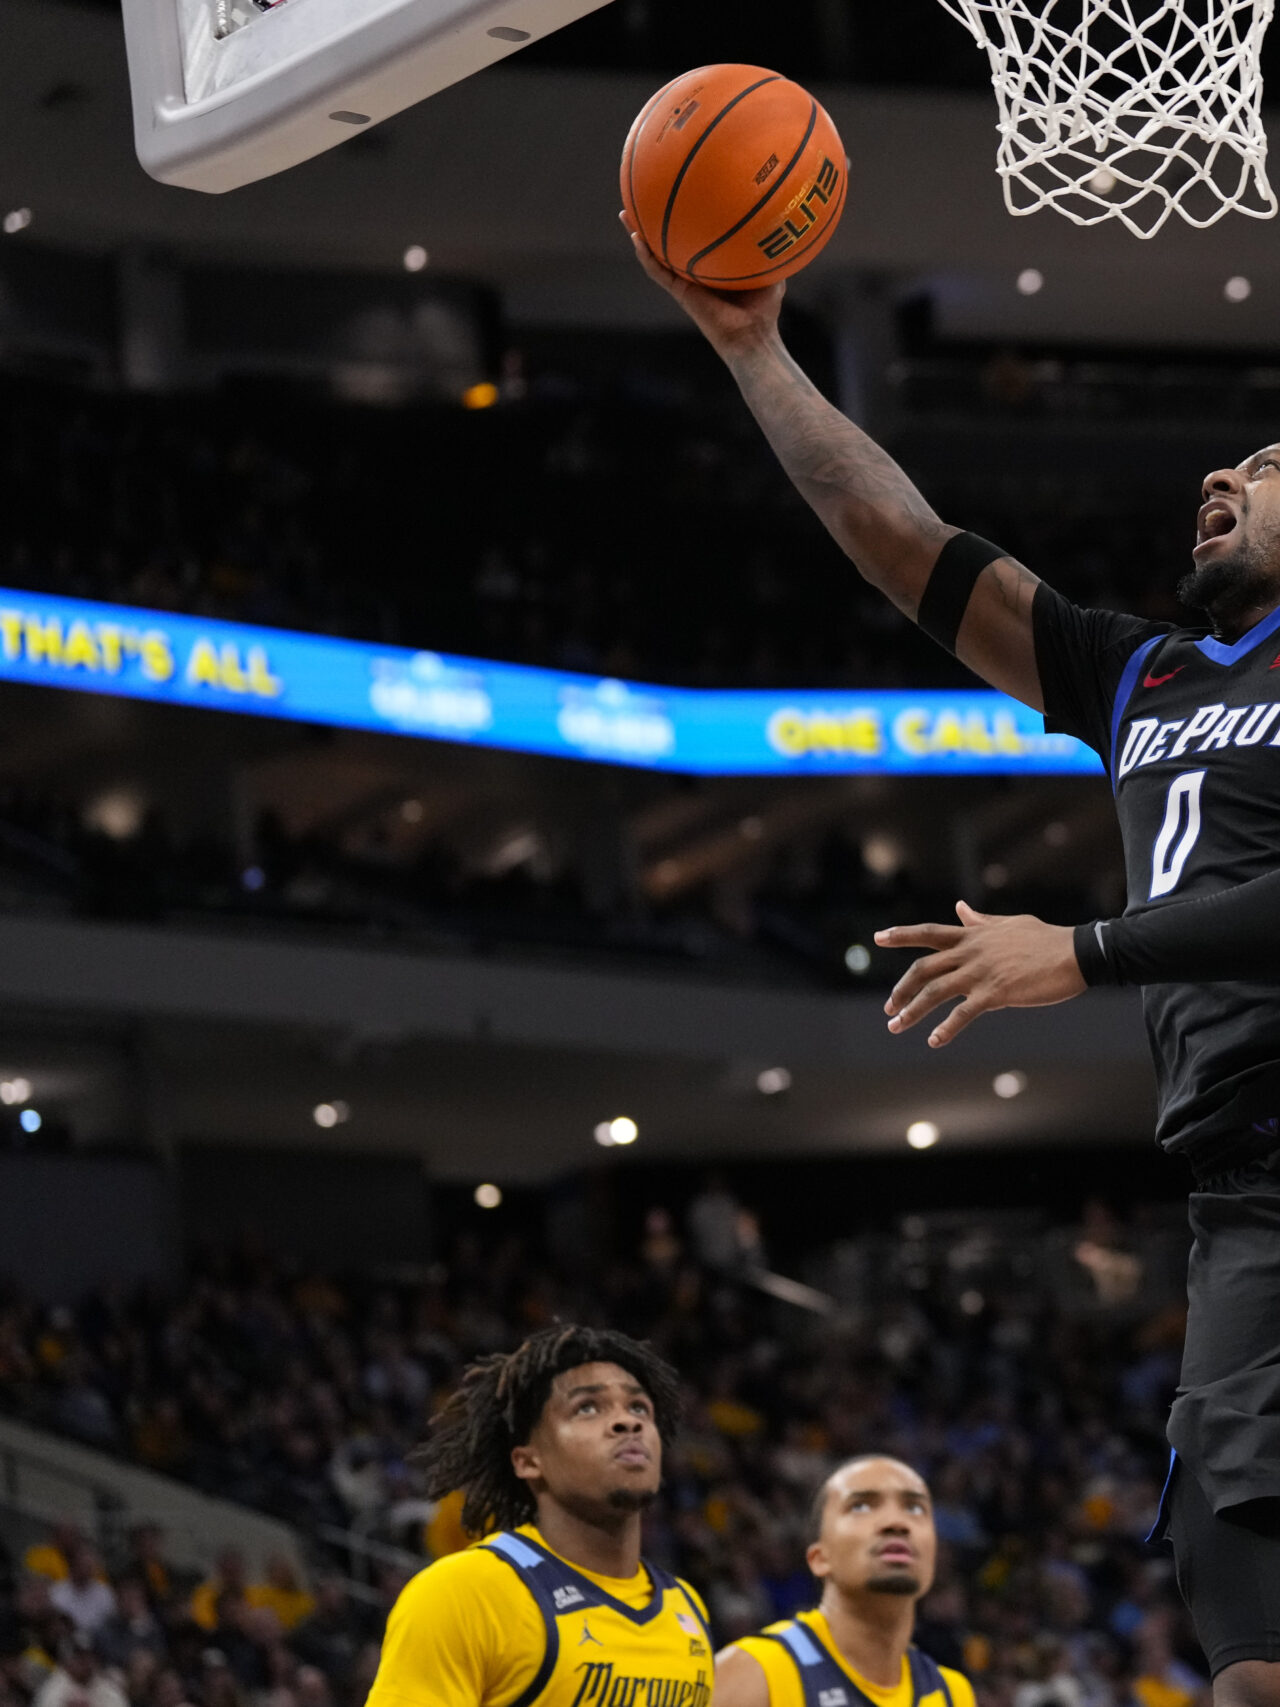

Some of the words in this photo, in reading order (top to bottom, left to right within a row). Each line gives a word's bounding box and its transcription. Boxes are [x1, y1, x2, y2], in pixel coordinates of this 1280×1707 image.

[757, 156, 840, 260] ELITE
[0, 608, 174, 682] THAT'S
[187, 636, 284, 699] ALL
[766, 707, 881, 758] ONE
[1147, 768, 1208, 903] 0
